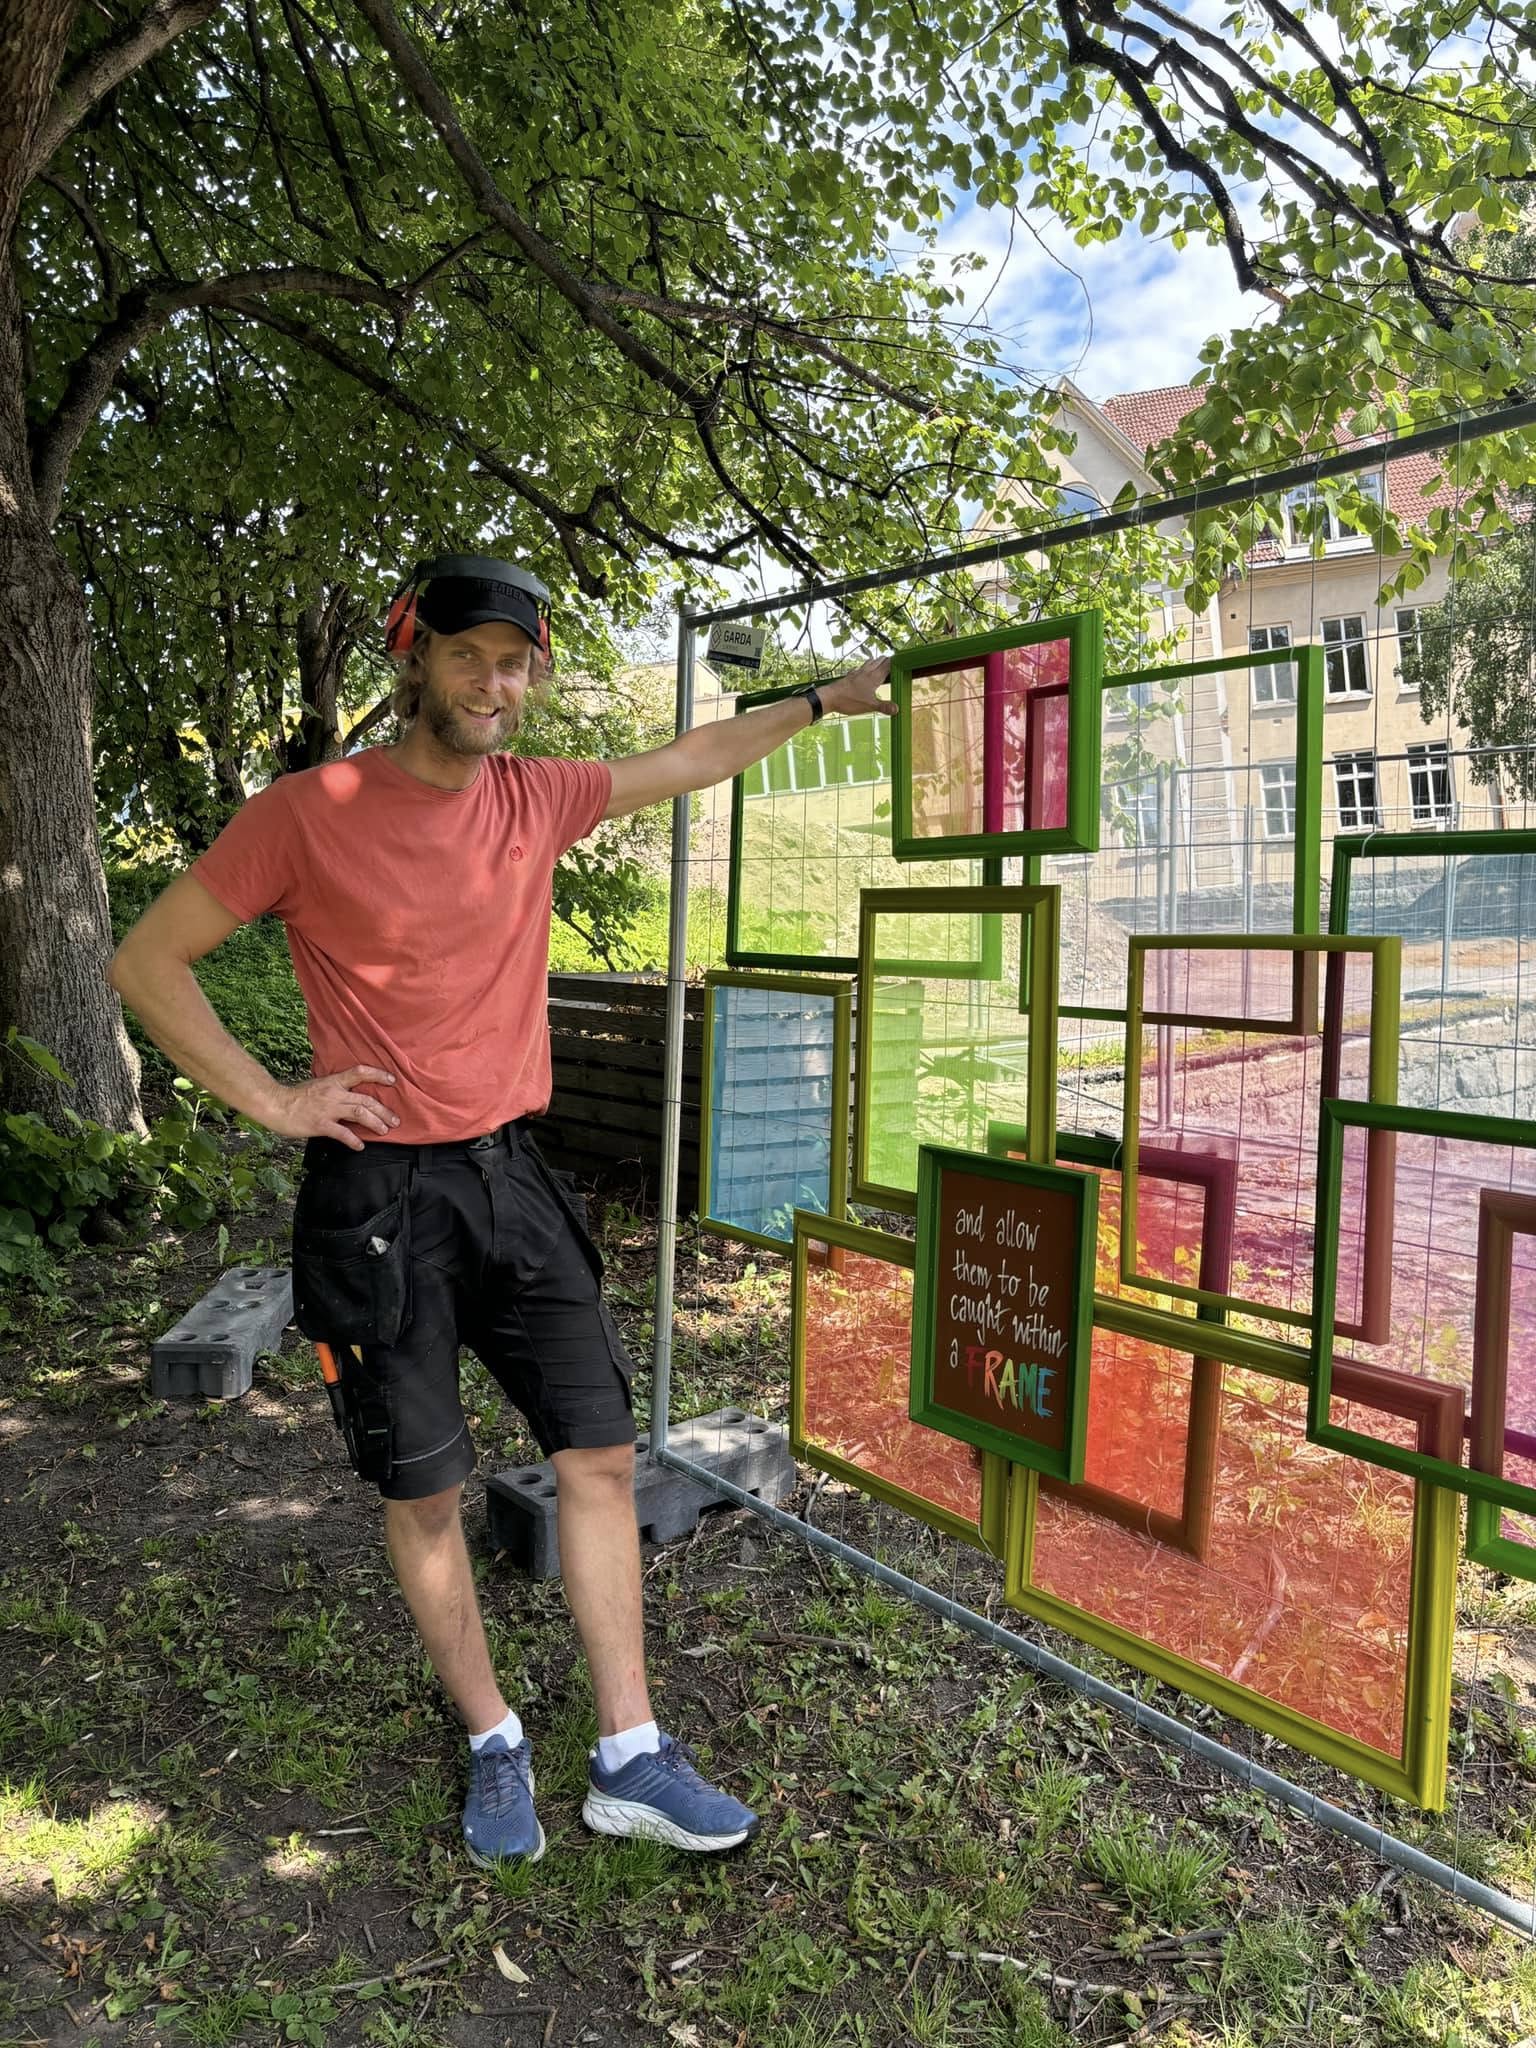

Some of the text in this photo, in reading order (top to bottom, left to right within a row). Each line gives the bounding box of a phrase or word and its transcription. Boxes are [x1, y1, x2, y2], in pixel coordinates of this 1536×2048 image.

[723, 630, 752, 646] GARDA
[955, 1204, 1041, 1252] and allow
[952, 1249, 1050, 1308] them to be
[950, 1293, 1068, 1359] caught within
[949, 1338, 1058, 1419] a FRAME
